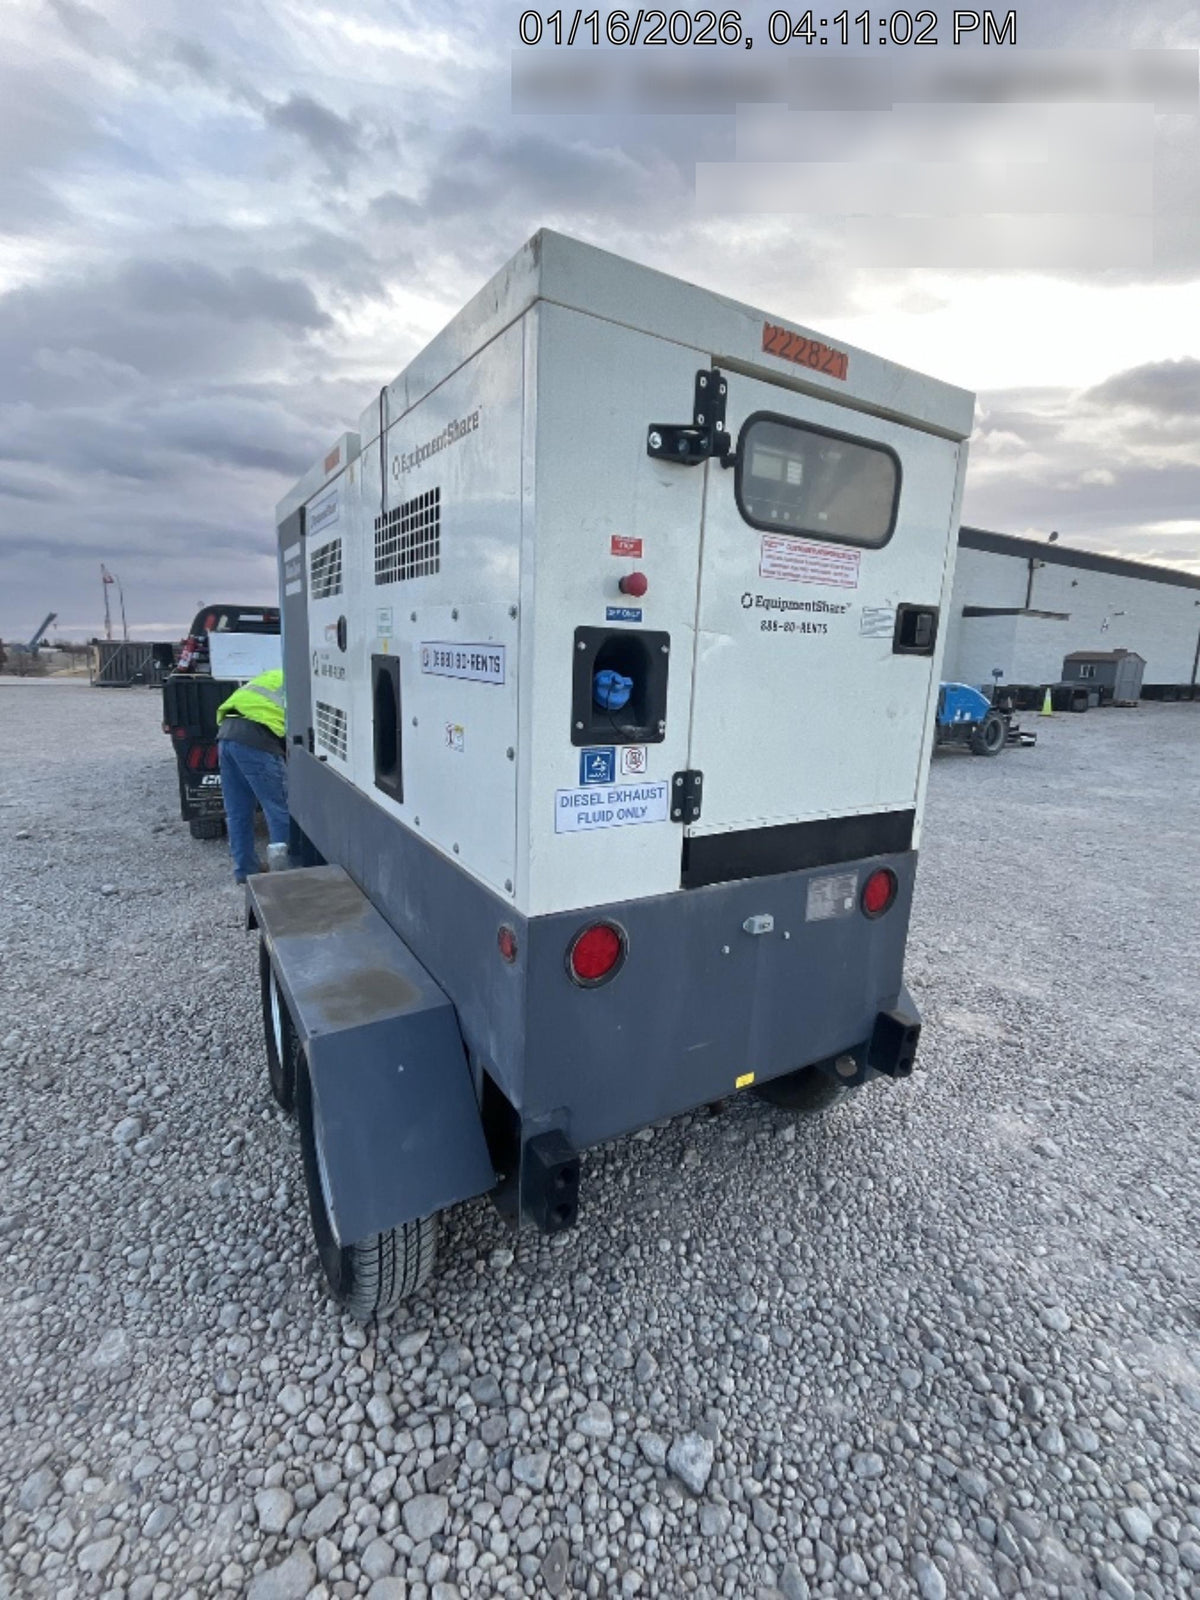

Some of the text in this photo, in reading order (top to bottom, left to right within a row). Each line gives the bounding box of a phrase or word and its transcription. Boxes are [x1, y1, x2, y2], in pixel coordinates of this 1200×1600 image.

[755, 595, 847, 614] EquipmentShare
[560, 787, 665, 808] DIESEL EXHAUST
[577, 806, 648, 825] FLUID ONLY
